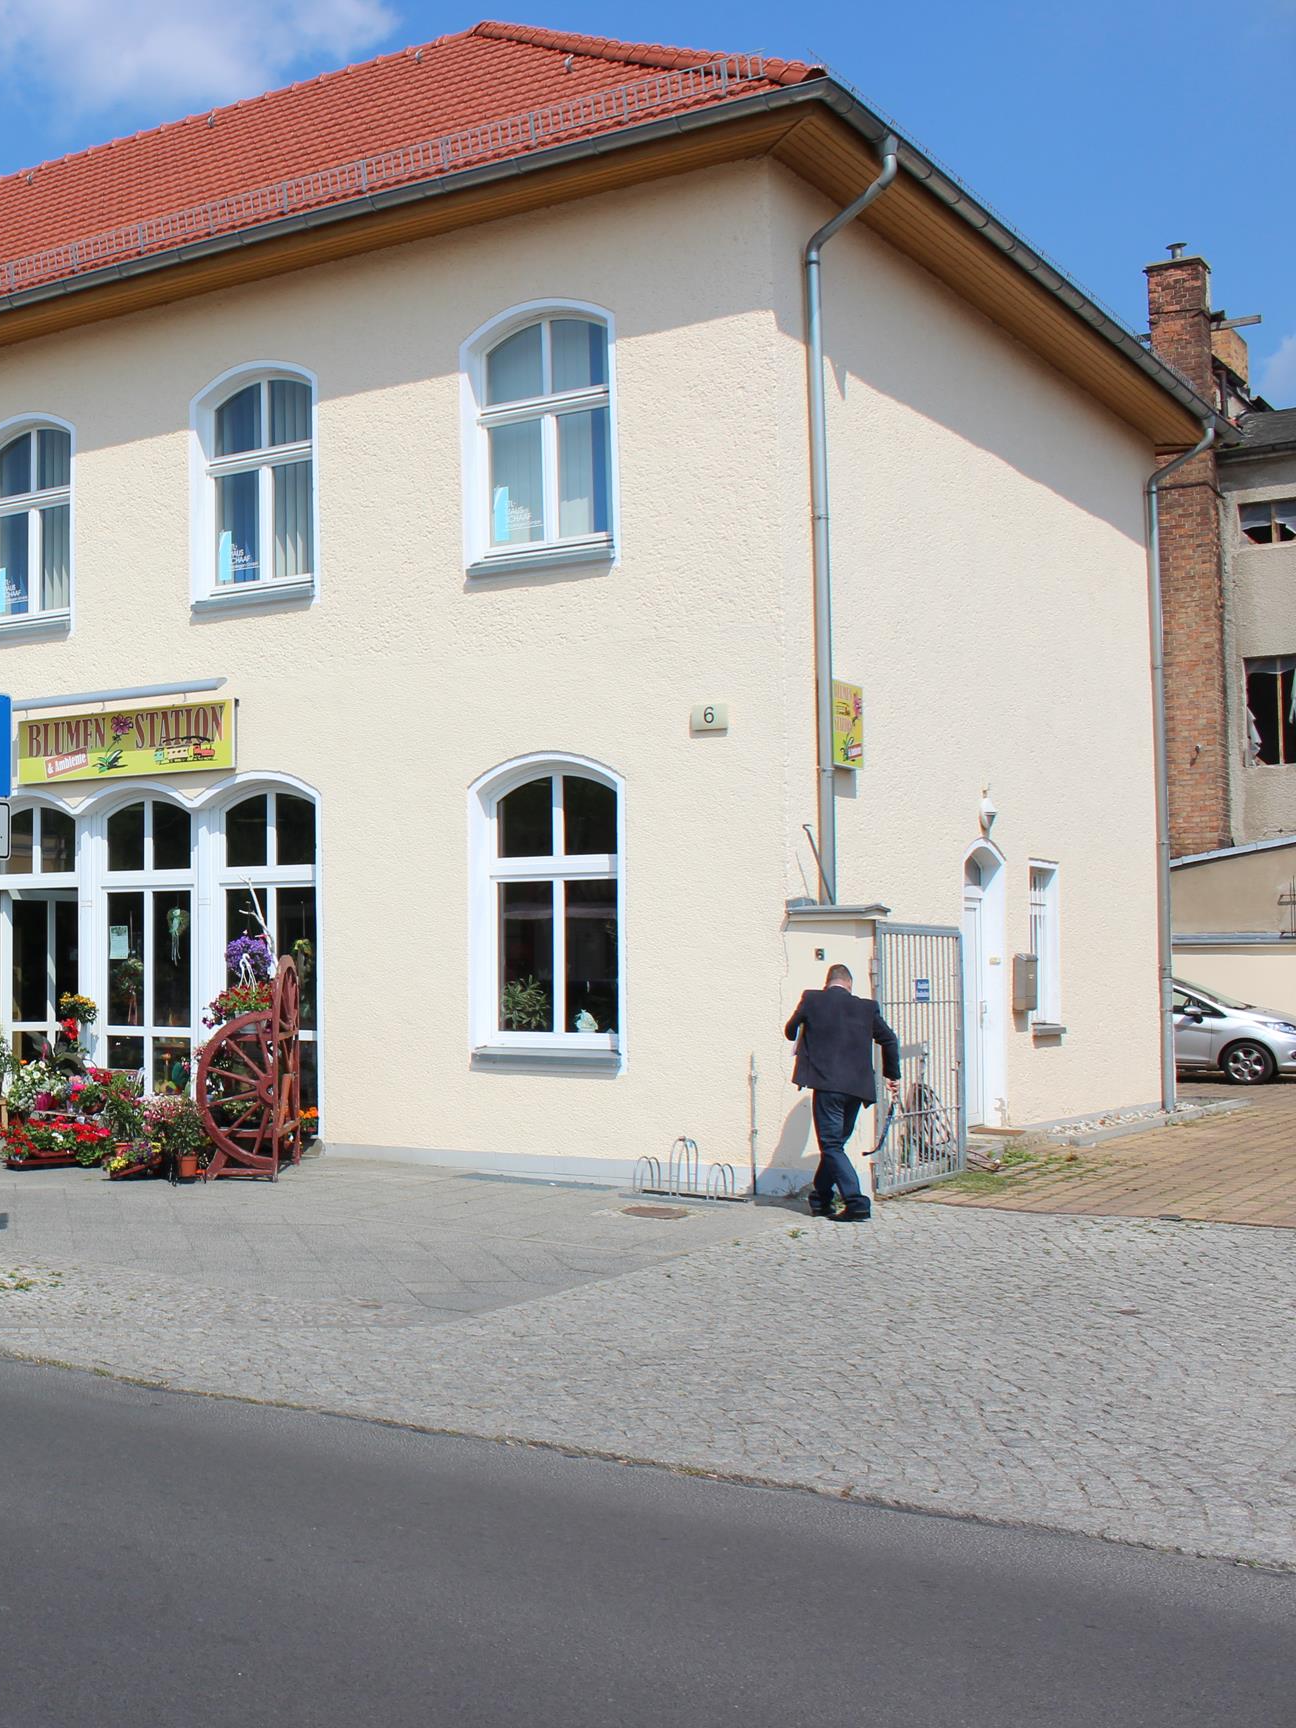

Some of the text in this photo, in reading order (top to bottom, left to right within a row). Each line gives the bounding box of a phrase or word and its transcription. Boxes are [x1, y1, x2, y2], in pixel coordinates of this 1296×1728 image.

[703, 706, 715, 724] 6
[27, 703, 225, 758] BLUMEN STATION
[47, 762, 54, 774] &
